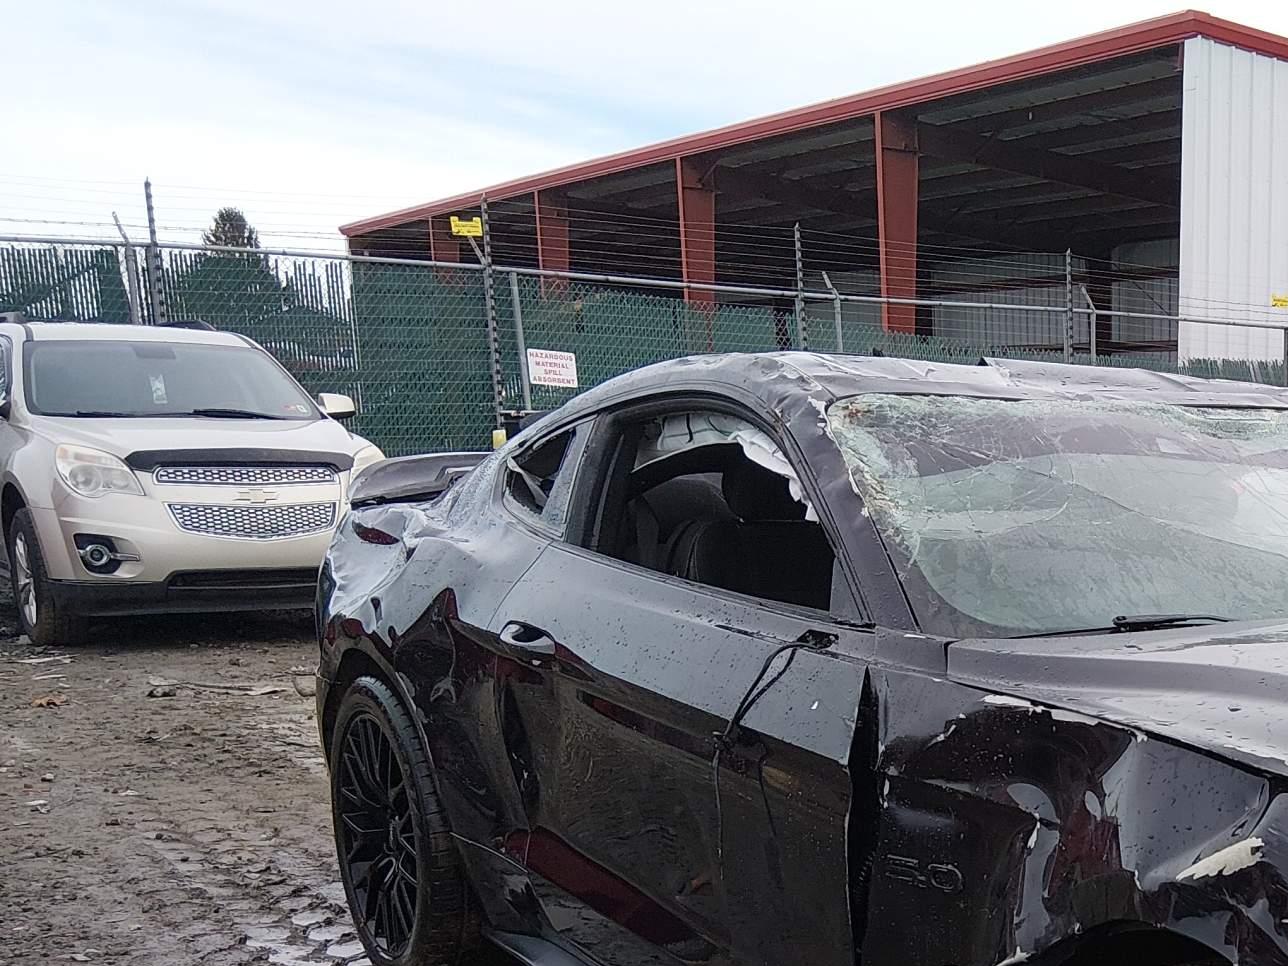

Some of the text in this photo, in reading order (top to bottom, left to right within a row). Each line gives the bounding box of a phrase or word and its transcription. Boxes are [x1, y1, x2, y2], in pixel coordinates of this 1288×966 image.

[529, 352, 573, 361] HAZARDOUS
[535, 361, 569, 369] MATERIAL
[533, 376, 575, 385] ABSORBENT
[885, 854, 964, 893] 5.0
